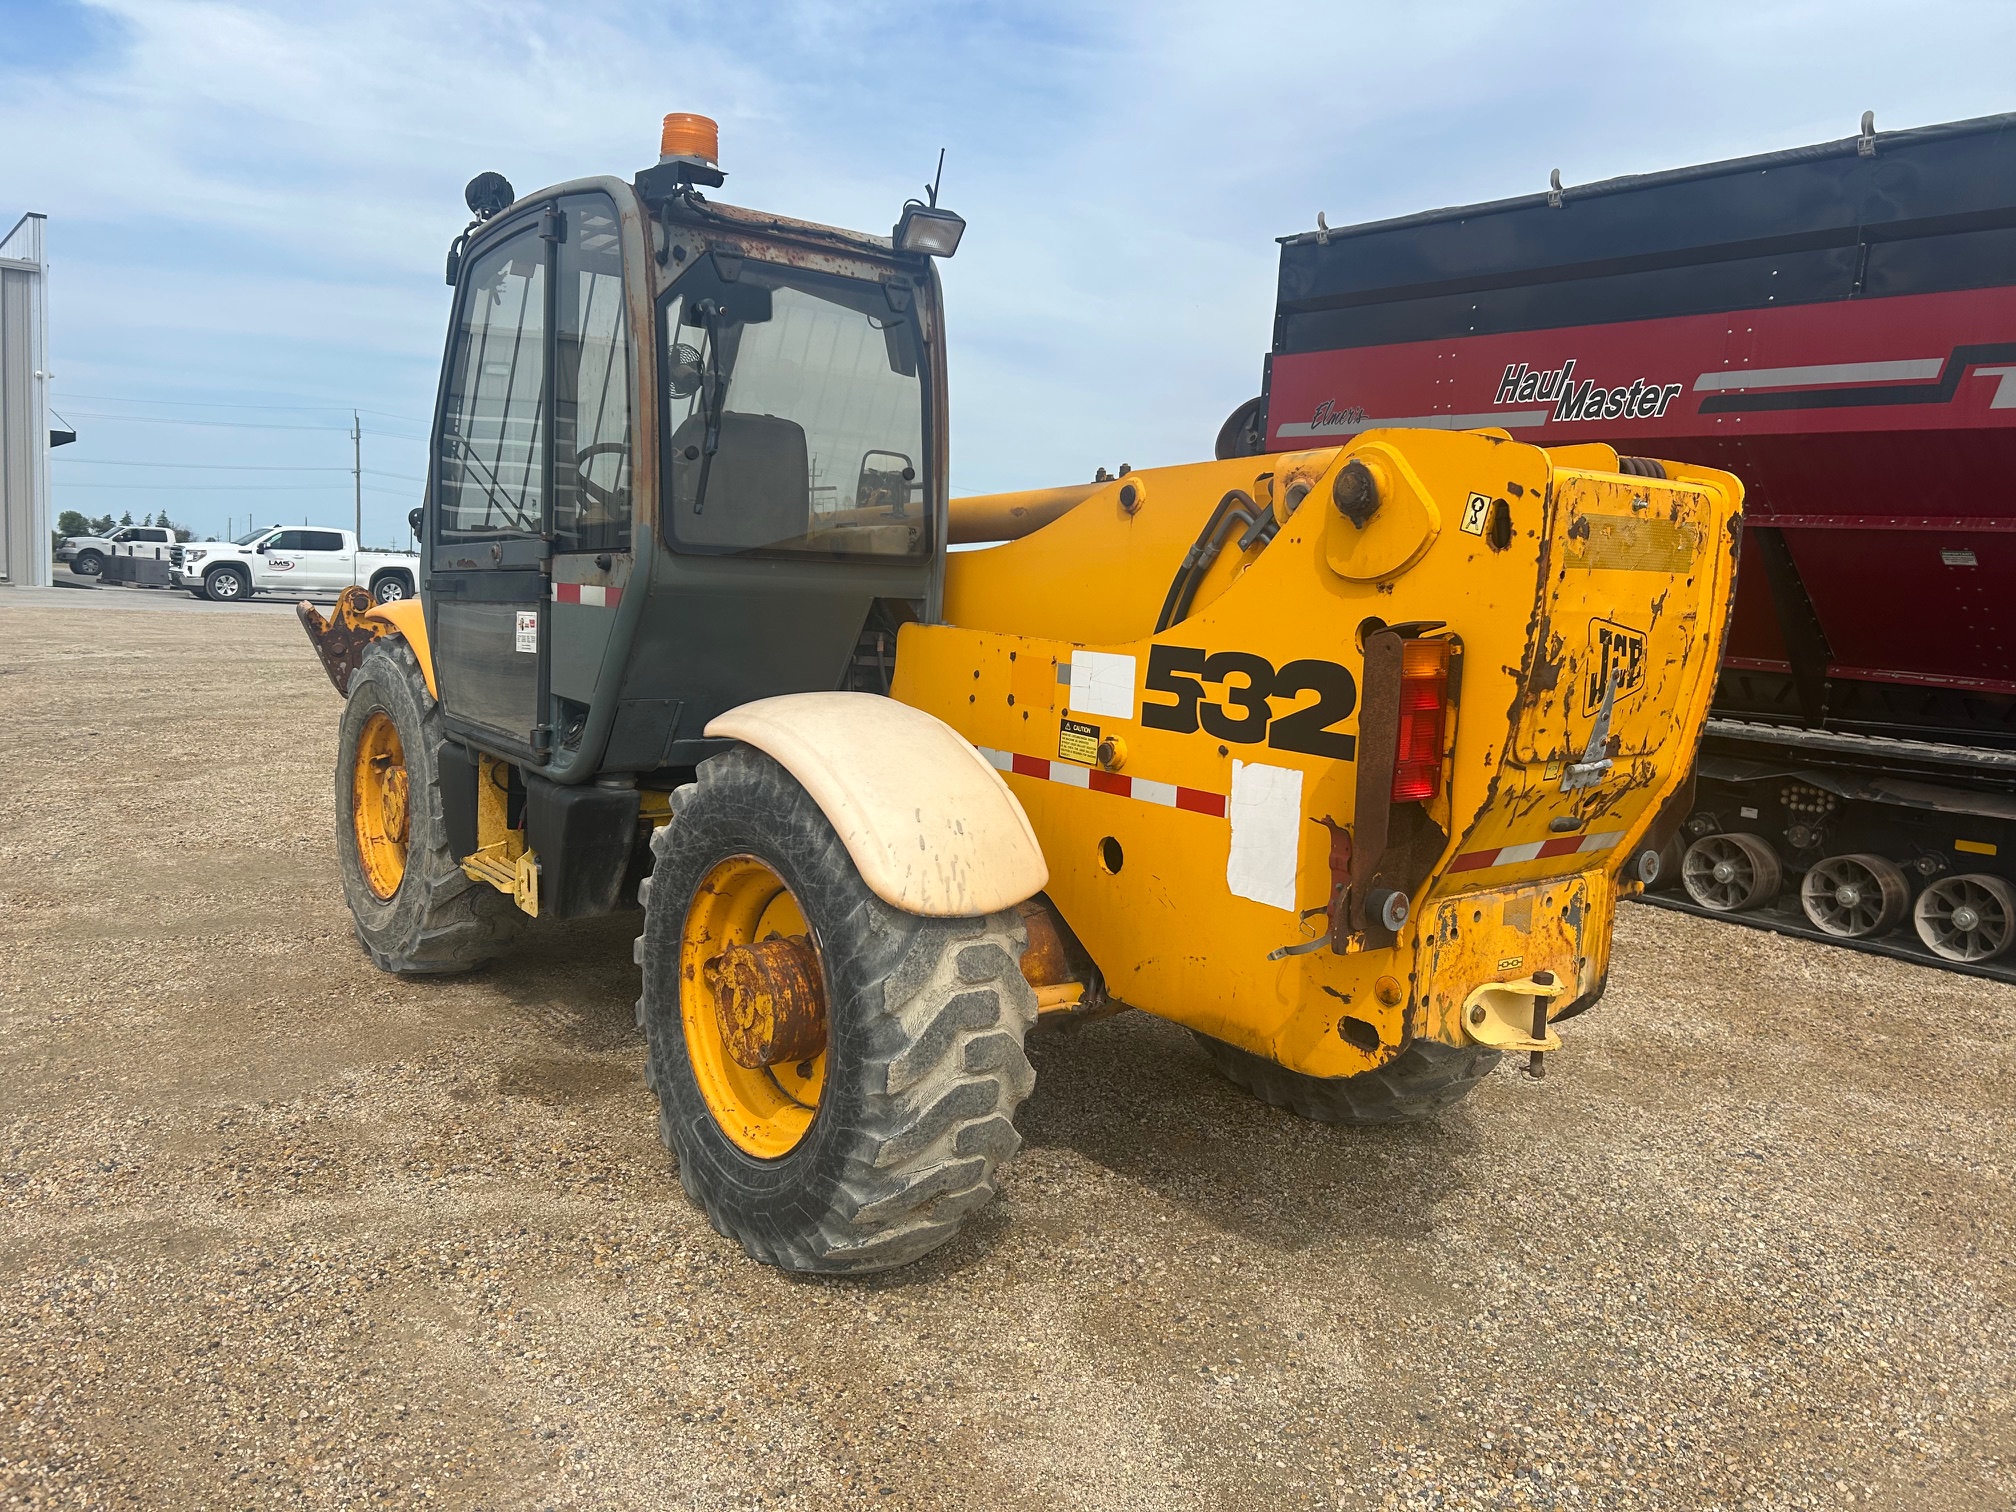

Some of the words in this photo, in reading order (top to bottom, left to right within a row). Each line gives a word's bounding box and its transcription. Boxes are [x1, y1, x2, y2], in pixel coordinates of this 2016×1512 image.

[1494, 359, 1576, 405] Haul
[1553, 377, 1682, 422] Master
[1141, 644, 1357, 762] 532
[1588, 628, 1643, 708] JCB
[1072, 724, 1092, 734] CAUTION
